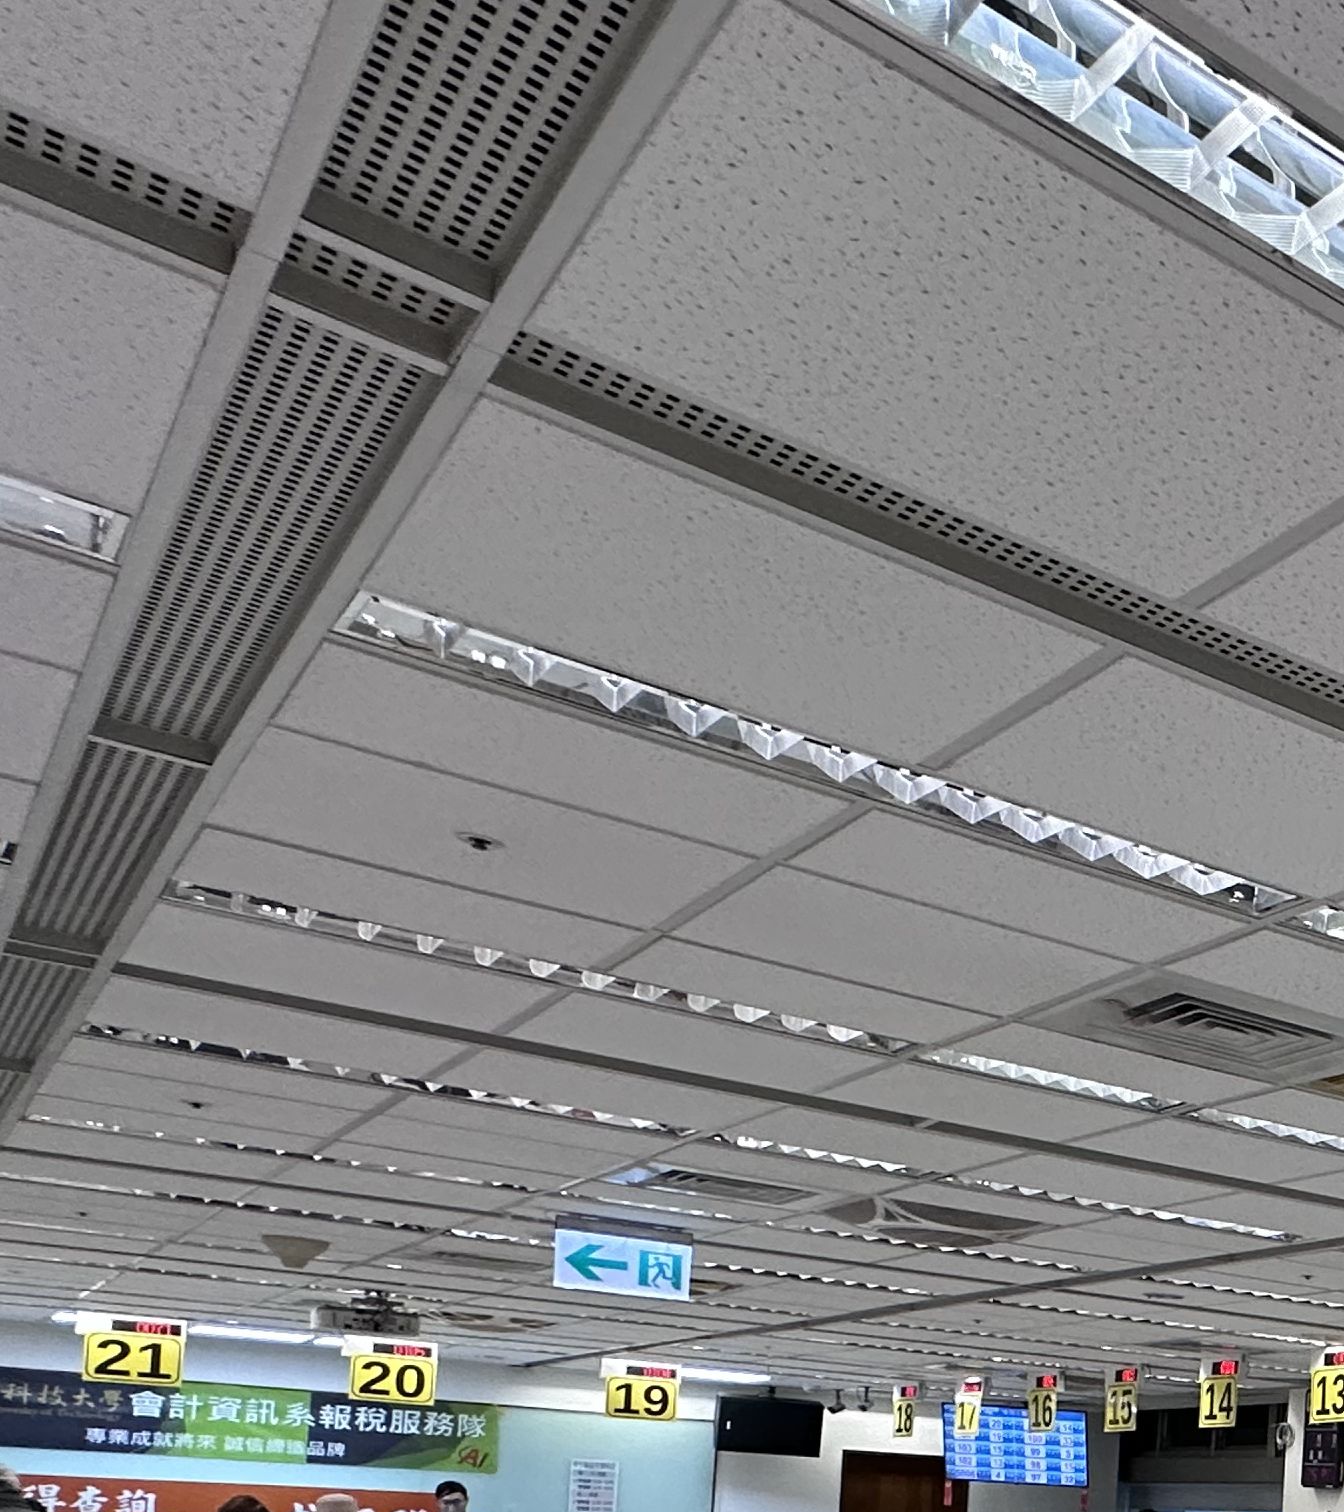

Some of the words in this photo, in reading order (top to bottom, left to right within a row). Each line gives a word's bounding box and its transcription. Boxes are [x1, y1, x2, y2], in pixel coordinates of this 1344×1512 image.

[94, 1339, 173, 1380] 21
[358, 1361, 425, 1398] 20
[129, 1390, 488, 1438] 會計資訊系報稅服務隊
[613, 1383, 669, 1416] 19
[896, 1402, 913, 1433] 18
[957, 1402, 977, 1430] 17
[1031, 1394, 1052, 1427] 16
[1108, 1390, 1133, 1426] 15
[1204, 1382, 1233, 1420] 14
